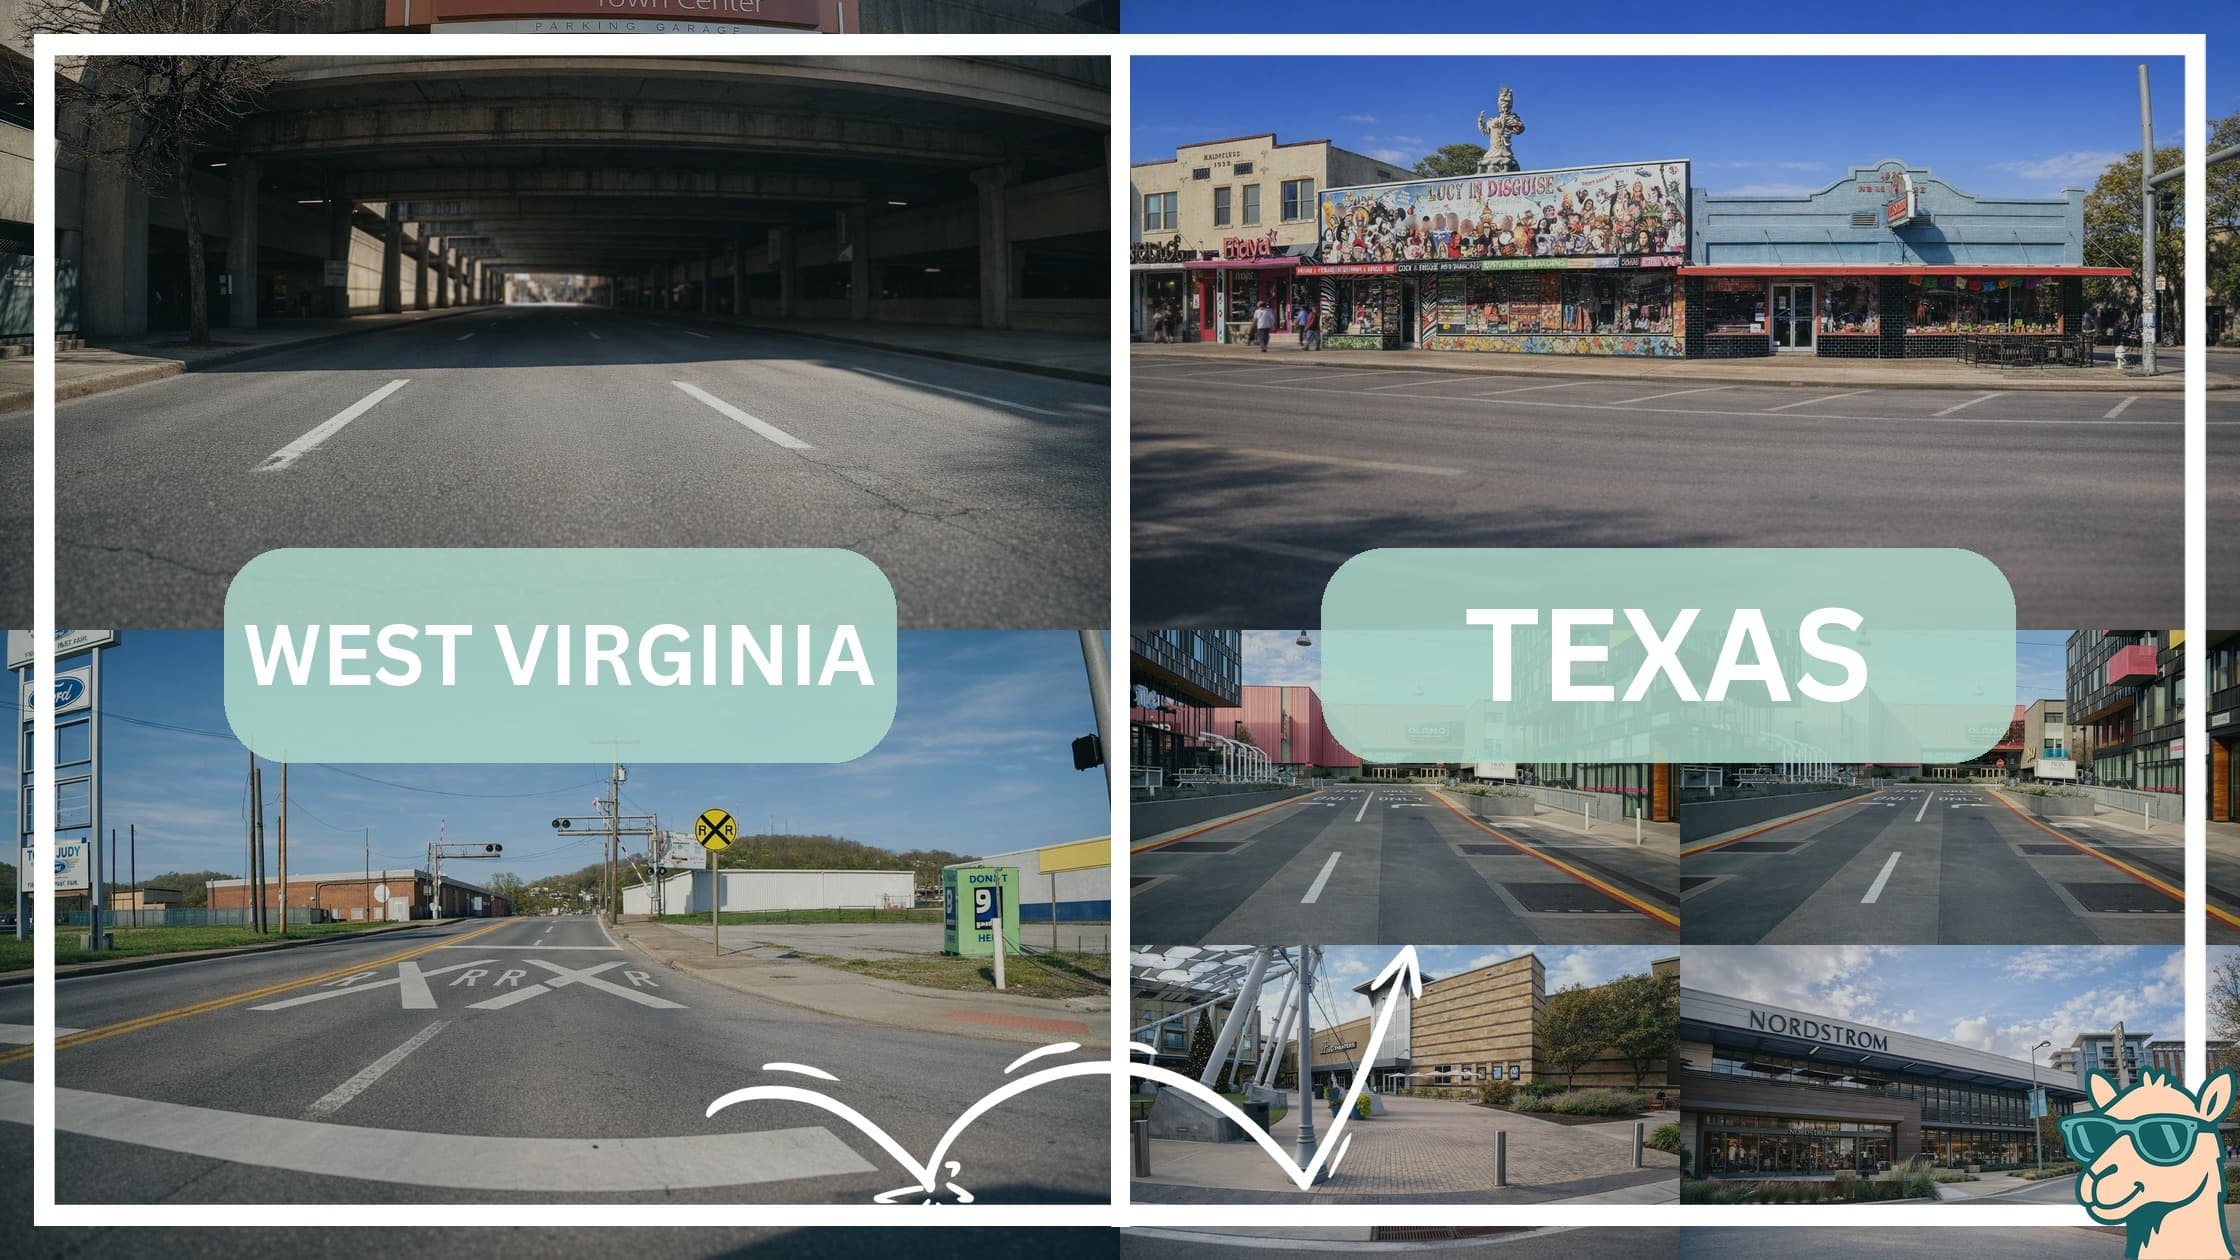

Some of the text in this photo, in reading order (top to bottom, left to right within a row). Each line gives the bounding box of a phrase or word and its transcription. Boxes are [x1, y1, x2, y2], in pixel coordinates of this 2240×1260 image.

[535, 22, 741, 34] PARKING GARAGE
[1427, 176, 1554, 201] LUCY IN DISGUISE
[698, 825, 733, 836] R R
[56, 846, 81, 858] JUDY
[449, 969, 489, 987] R
[494, 969, 661, 987] R R
[1750, 1010, 1888, 1051] NORDSTROM
[1789, 1128, 1833, 1137] NORDSTROM
